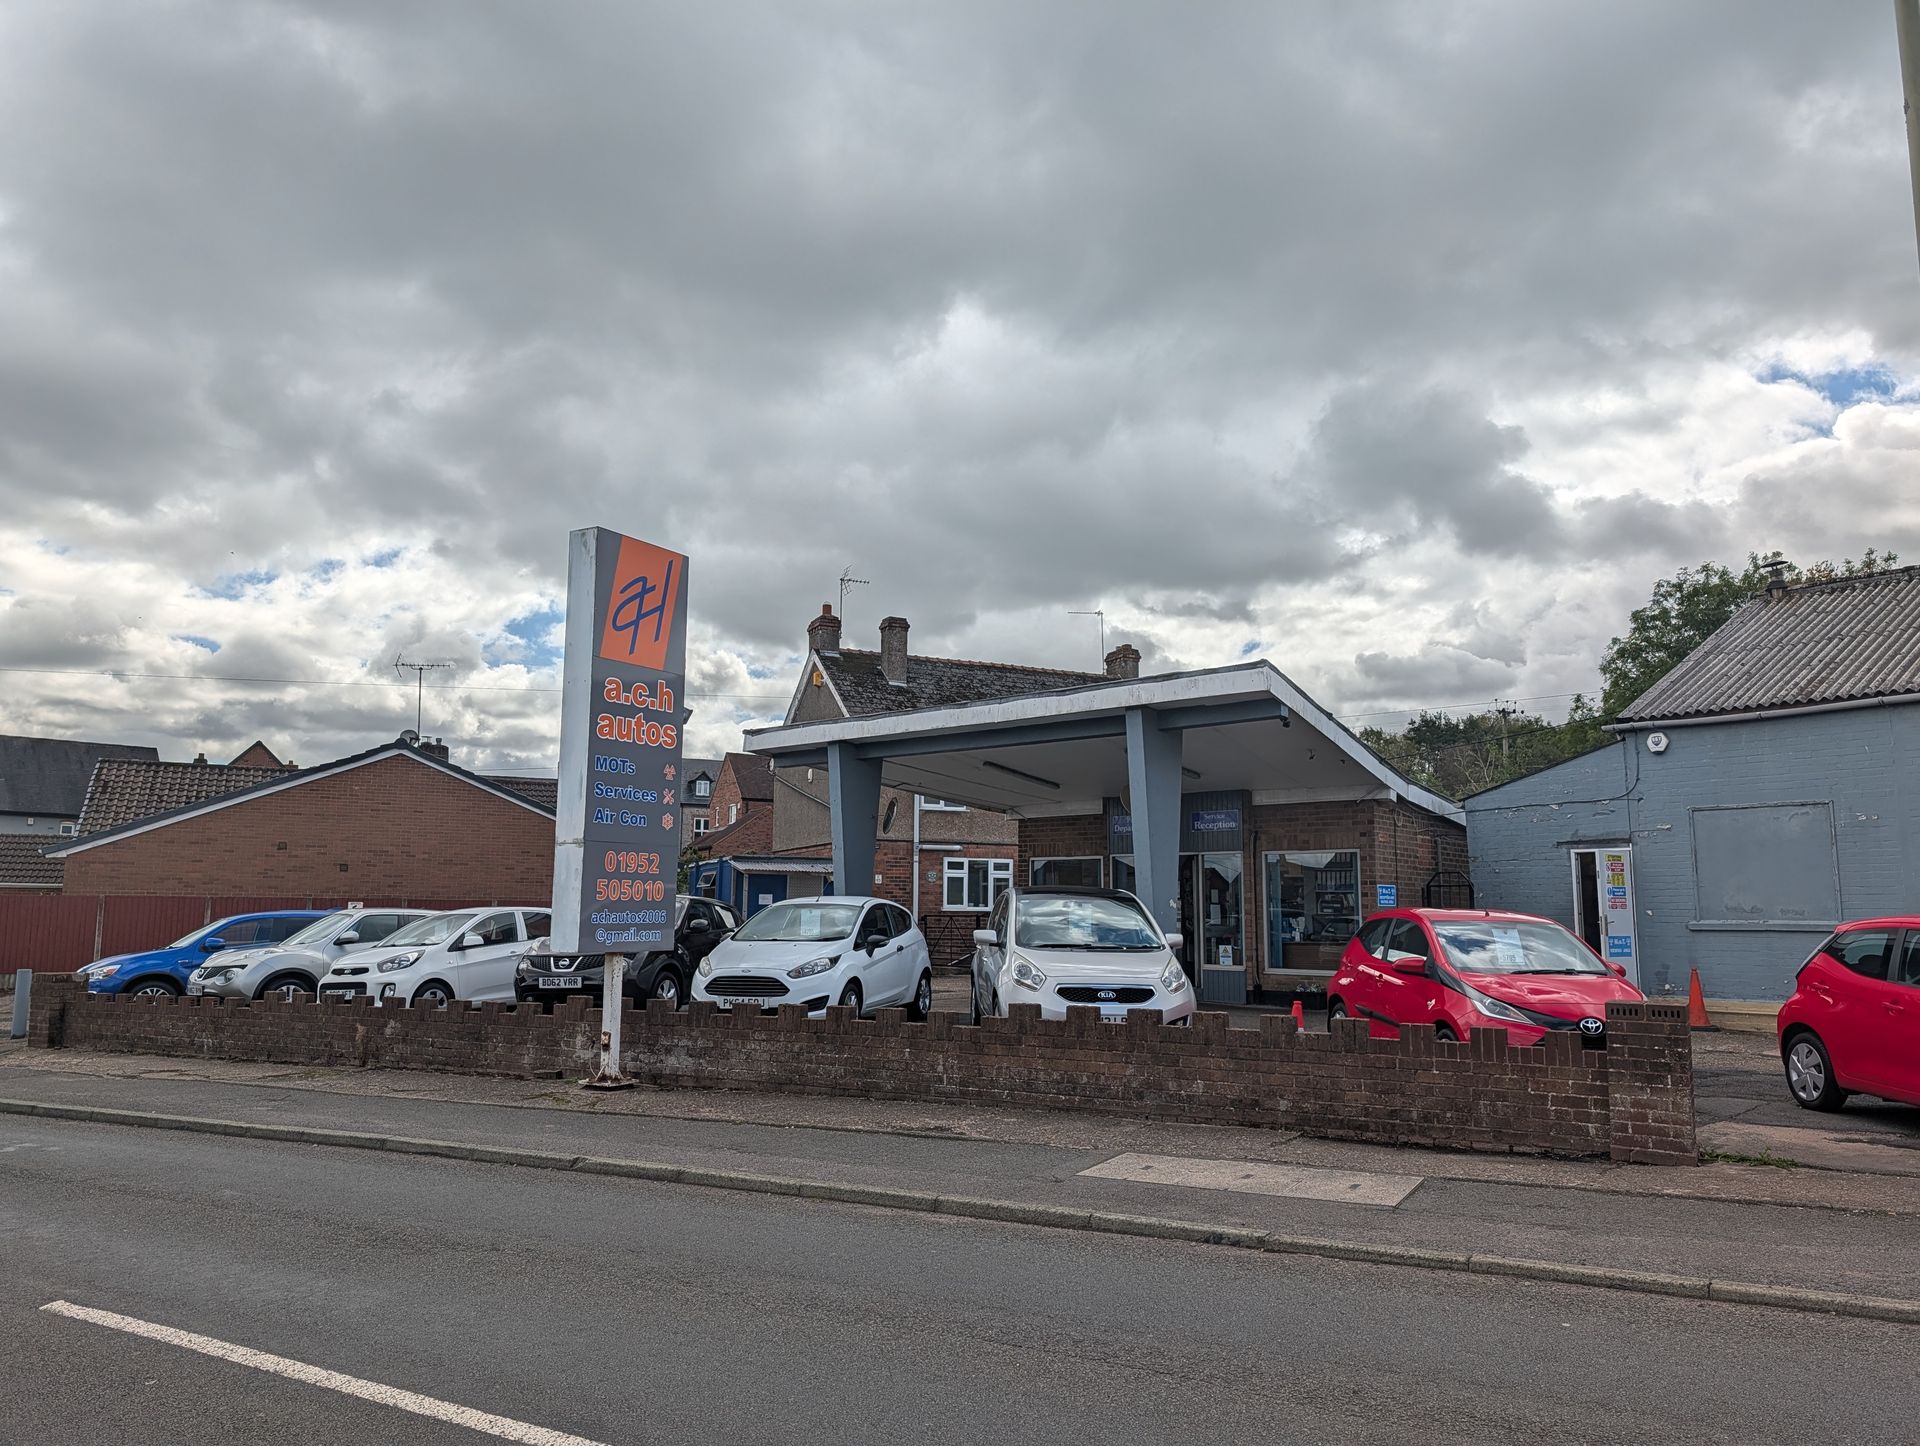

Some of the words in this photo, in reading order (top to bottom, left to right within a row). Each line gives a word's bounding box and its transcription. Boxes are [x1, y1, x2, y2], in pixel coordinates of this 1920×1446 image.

[604, 677, 674, 712] a.c.h
[596, 712, 677, 749] autos
[594, 754, 636, 775] MOTs
[594, 781, 657, 803] Services
[593, 807, 616, 824] Air
[620, 809, 648, 827] Con
[1194, 820, 1237, 830] Reception
[604, 850, 660, 874] 01952
[595, 879, 665, 902] 505010
[591, 908, 667, 924] achautos2006
[595, 927, 662, 946] @gmail.com
[541, 978, 562, 987] BD62
[563, 977, 579, 986] VRR
